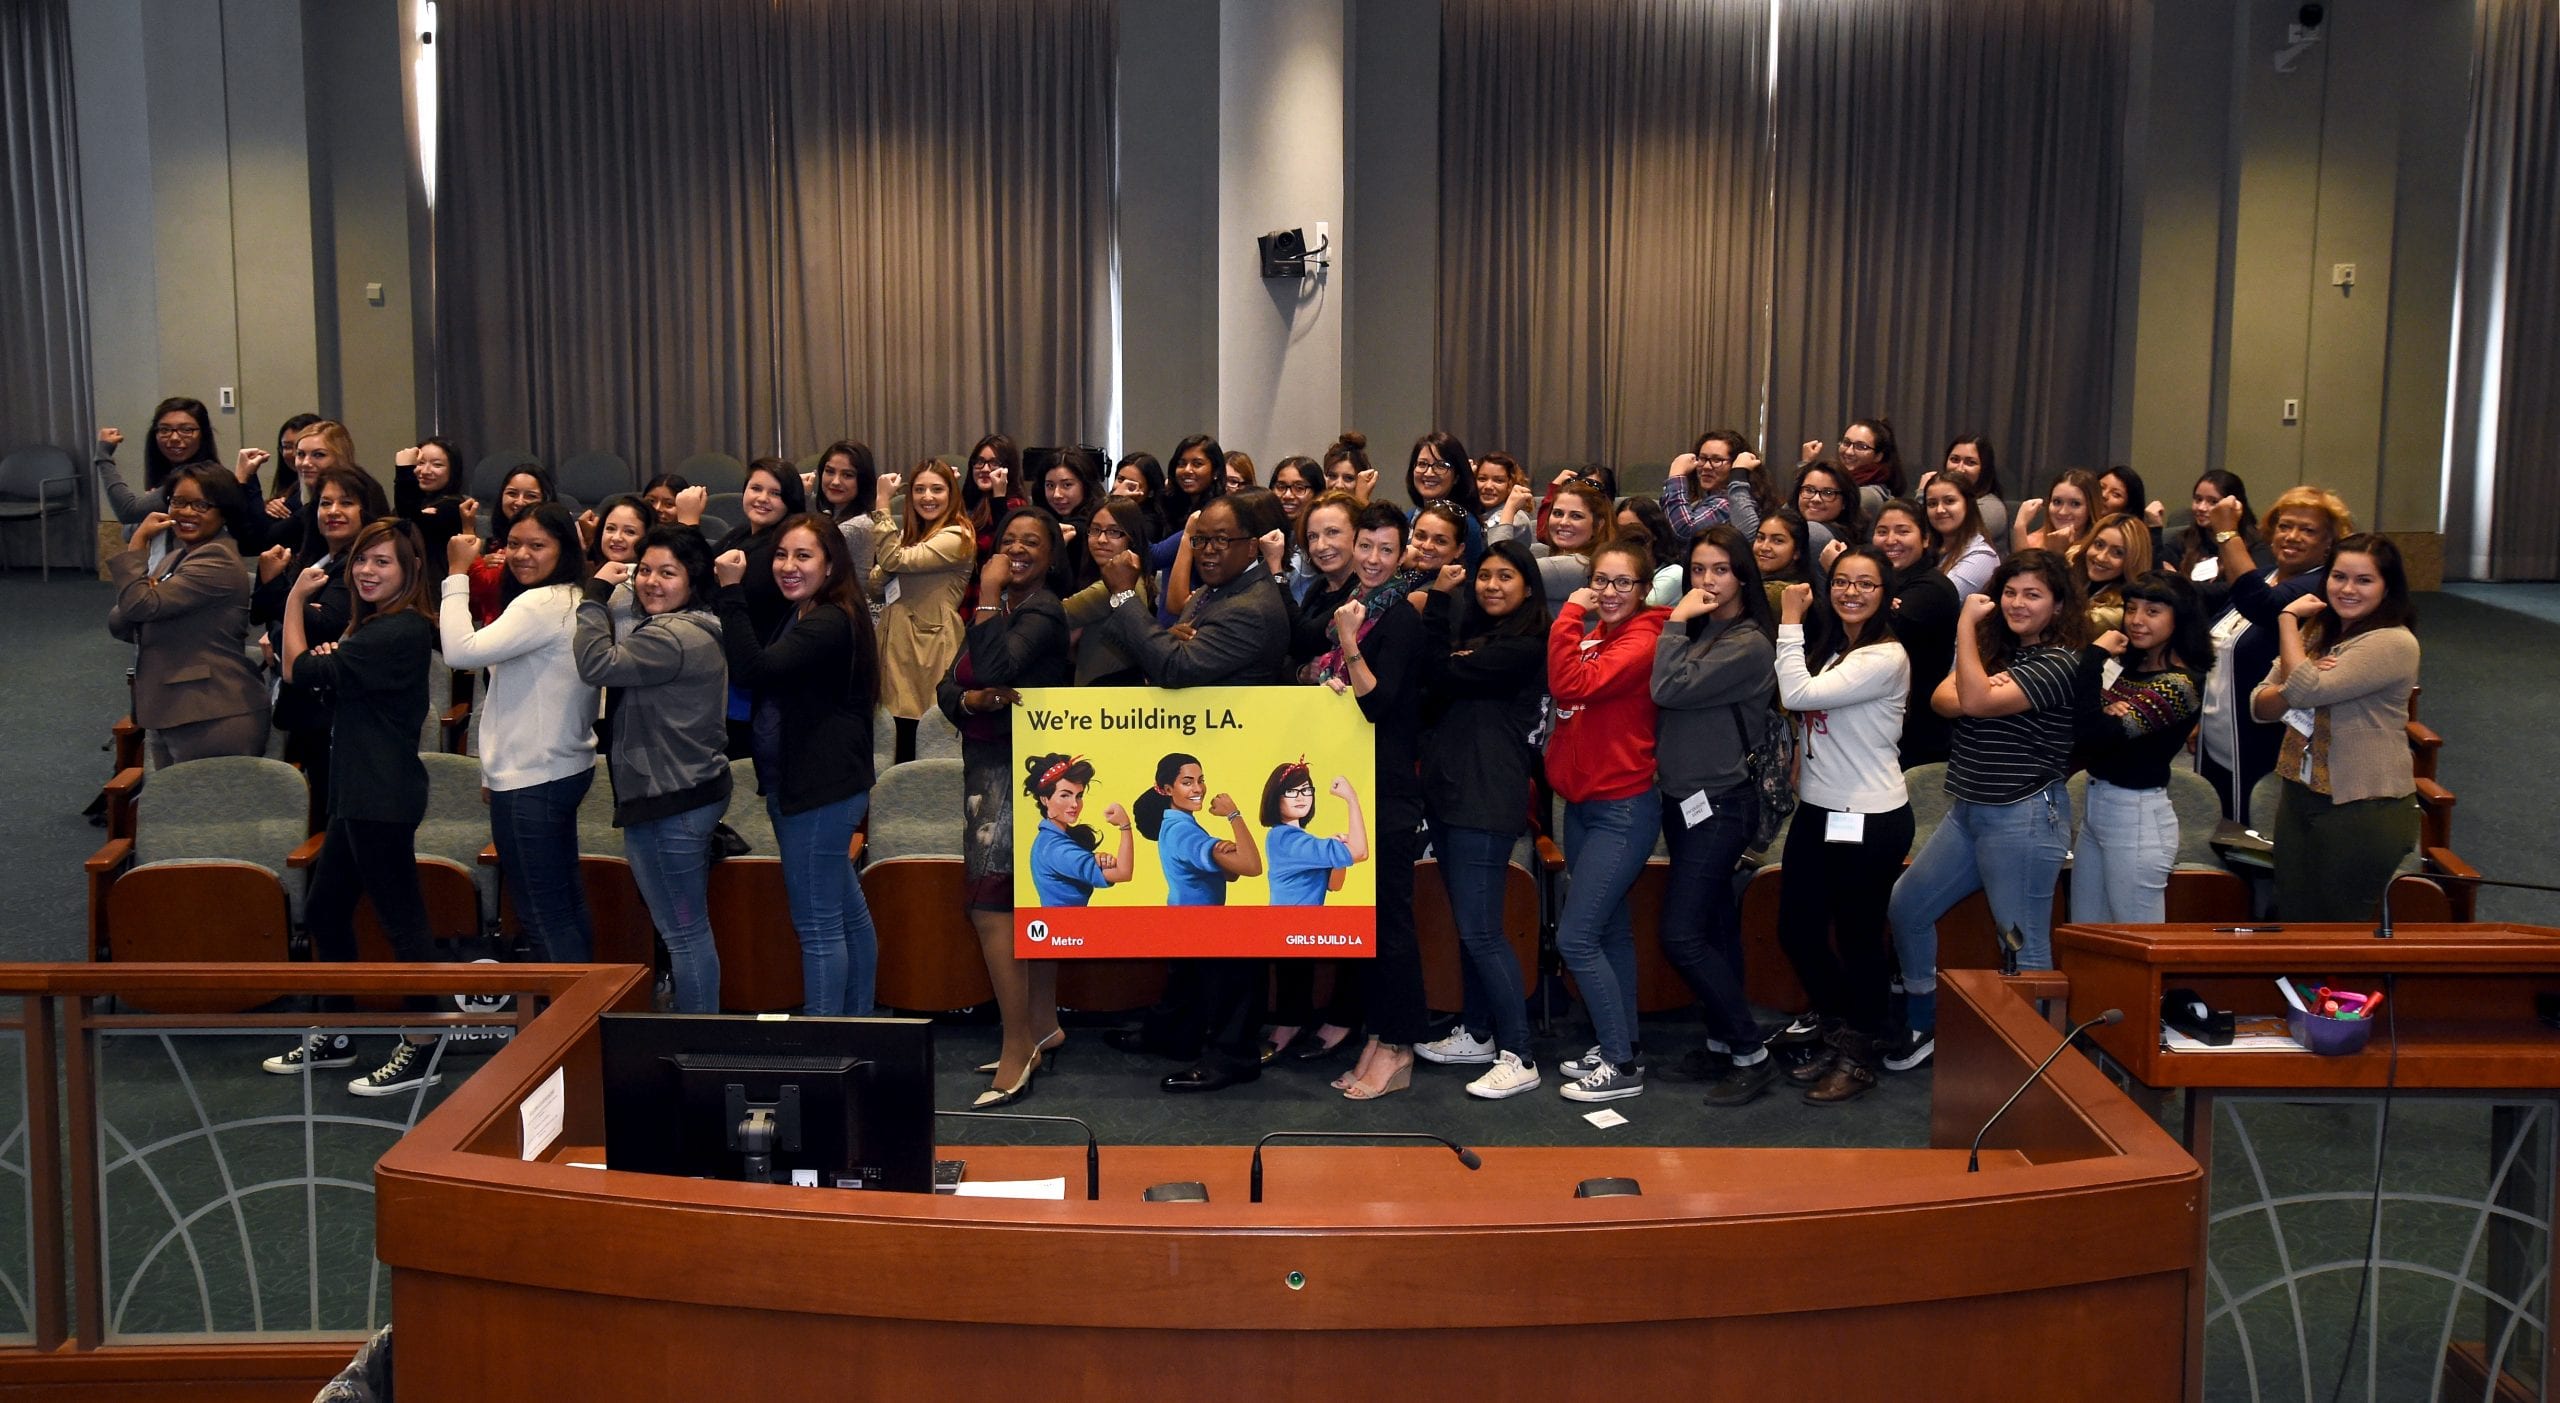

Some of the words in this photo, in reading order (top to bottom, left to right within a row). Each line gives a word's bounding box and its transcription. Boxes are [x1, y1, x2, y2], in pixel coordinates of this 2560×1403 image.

[1027, 709, 1093, 731] We're
[1100, 708, 1197, 736] building
[1205, 709, 1244, 729] LA.
[1031, 924, 1045, 938] M
[1051, 936, 1084, 946] Metro
[1286, 935, 1316, 945] GIRLS
[1317, 935, 1347, 945] BUILD
[1348, 935, 1363, 945] LA
